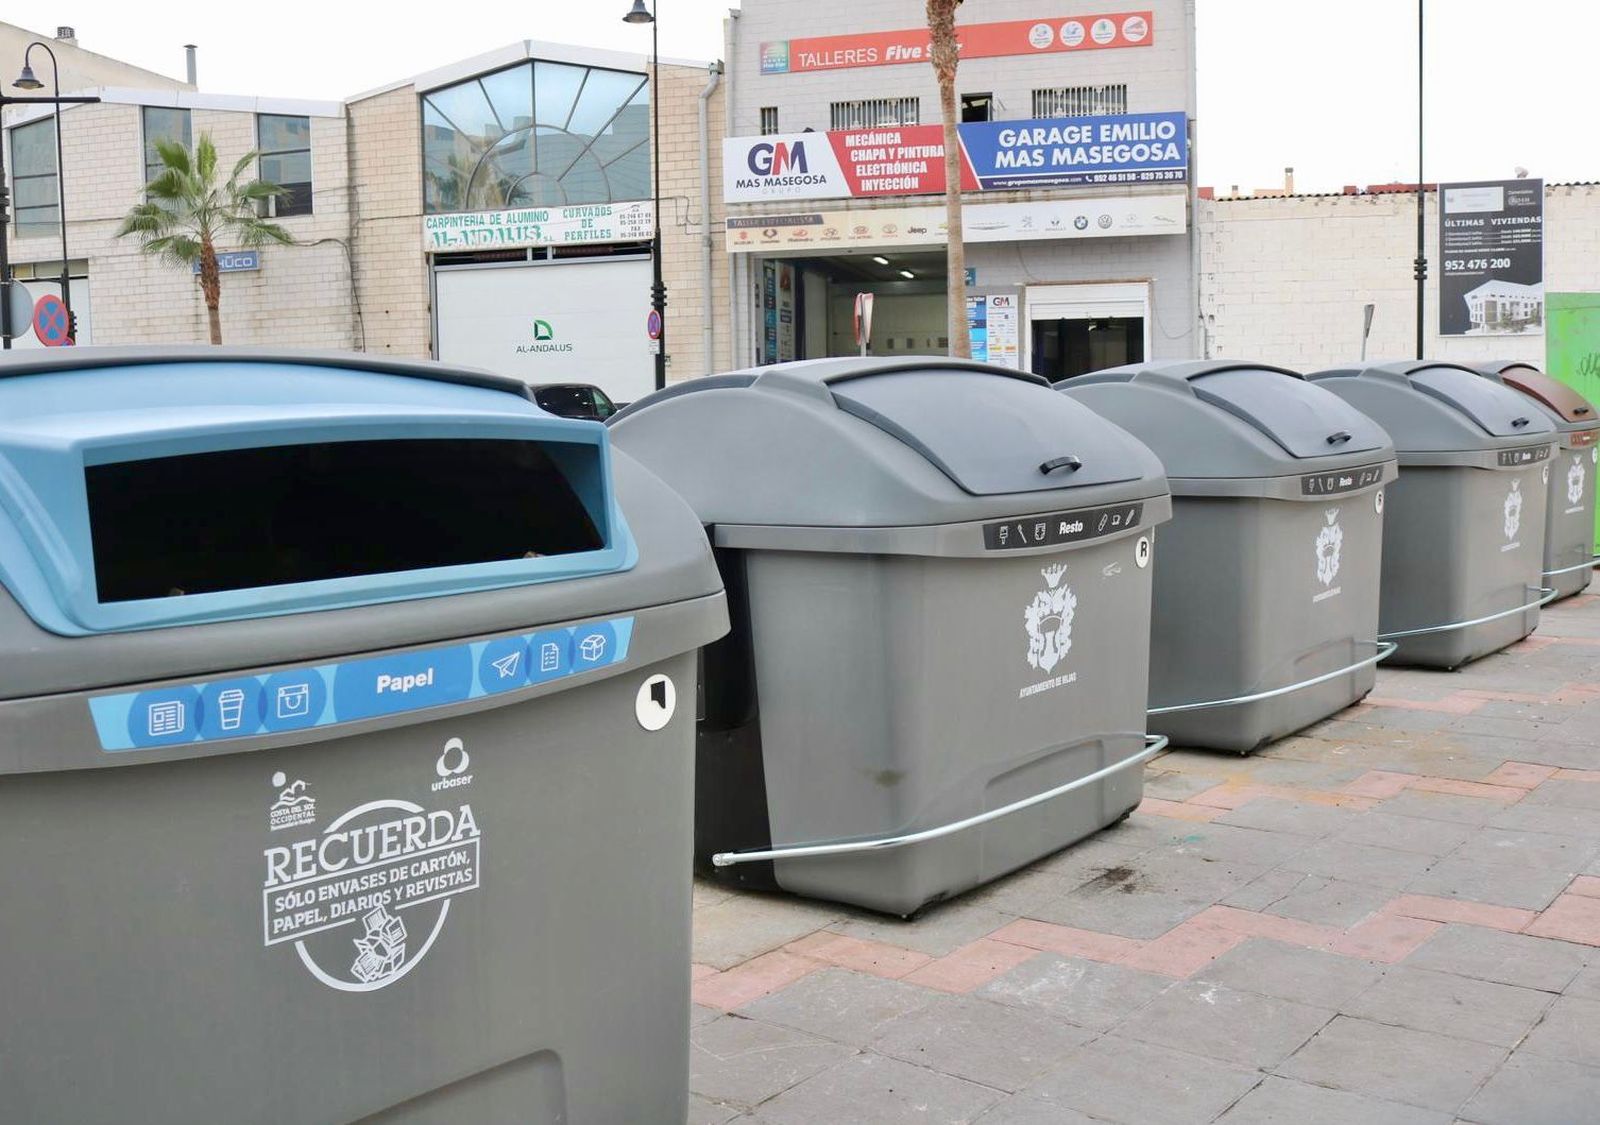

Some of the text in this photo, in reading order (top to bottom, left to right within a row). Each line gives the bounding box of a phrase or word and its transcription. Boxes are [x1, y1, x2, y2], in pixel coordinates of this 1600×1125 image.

[799, 48, 878, 67] TALLERES
[885, 45, 922, 60] Five
[926, 43, 963, 58] Sr
[846, 132, 901, 148] MECÁNICA
[999, 120, 1177, 148] GARAGE EMILIO
[748, 140, 808, 176] GM
[851, 145, 945, 162] CHAPA Y PINTURA
[994, 142, 1181, 170] MAS MASEGOSA
[856, 160, 927, 177] ELECTRÓNICA
[736, 174, 827, 189] MAS MASEGOSA
[862, 176, 919, 192] INYECCIÓN
[426, 210, 550, 230] CARPINTERIA DE ALUMINIO
[562, 206, 613, 219] CURVADOS
[581, 218, 594, 229] DE
[1445, 216, 1542, 228] ÚLTIMAS VIVIENDAS
[565, 230, 612, 241] PERFILES
[908, 226, 927, 236] Jeep
[217, 255, 252, 269] HÜCO
[1445, 258, 1511, 271] 952 476 200
[993, 296, 1009, 306] GM
[516, 343, 573, 354] AL-ANDALUS
[1059, 520, 1083, 535] Resto
[1140, 541, 1148, 558] R
[376, 666, 433, 694] Papel
[432, 775, 473, 792] urbaser
[270, 807, 290, 818] COSTA
[303, 803, 315, 811] SOL
[271, 810, 315, 825] OCCIDENTAL
[263, 804, 481, 887] RECUERDA
[275, 850, 470, 913] SÓLO ENVASES DE CARTÓN,
[273, 868, 473, 934] PAPEL, DIARIOS Y REVISTAS
